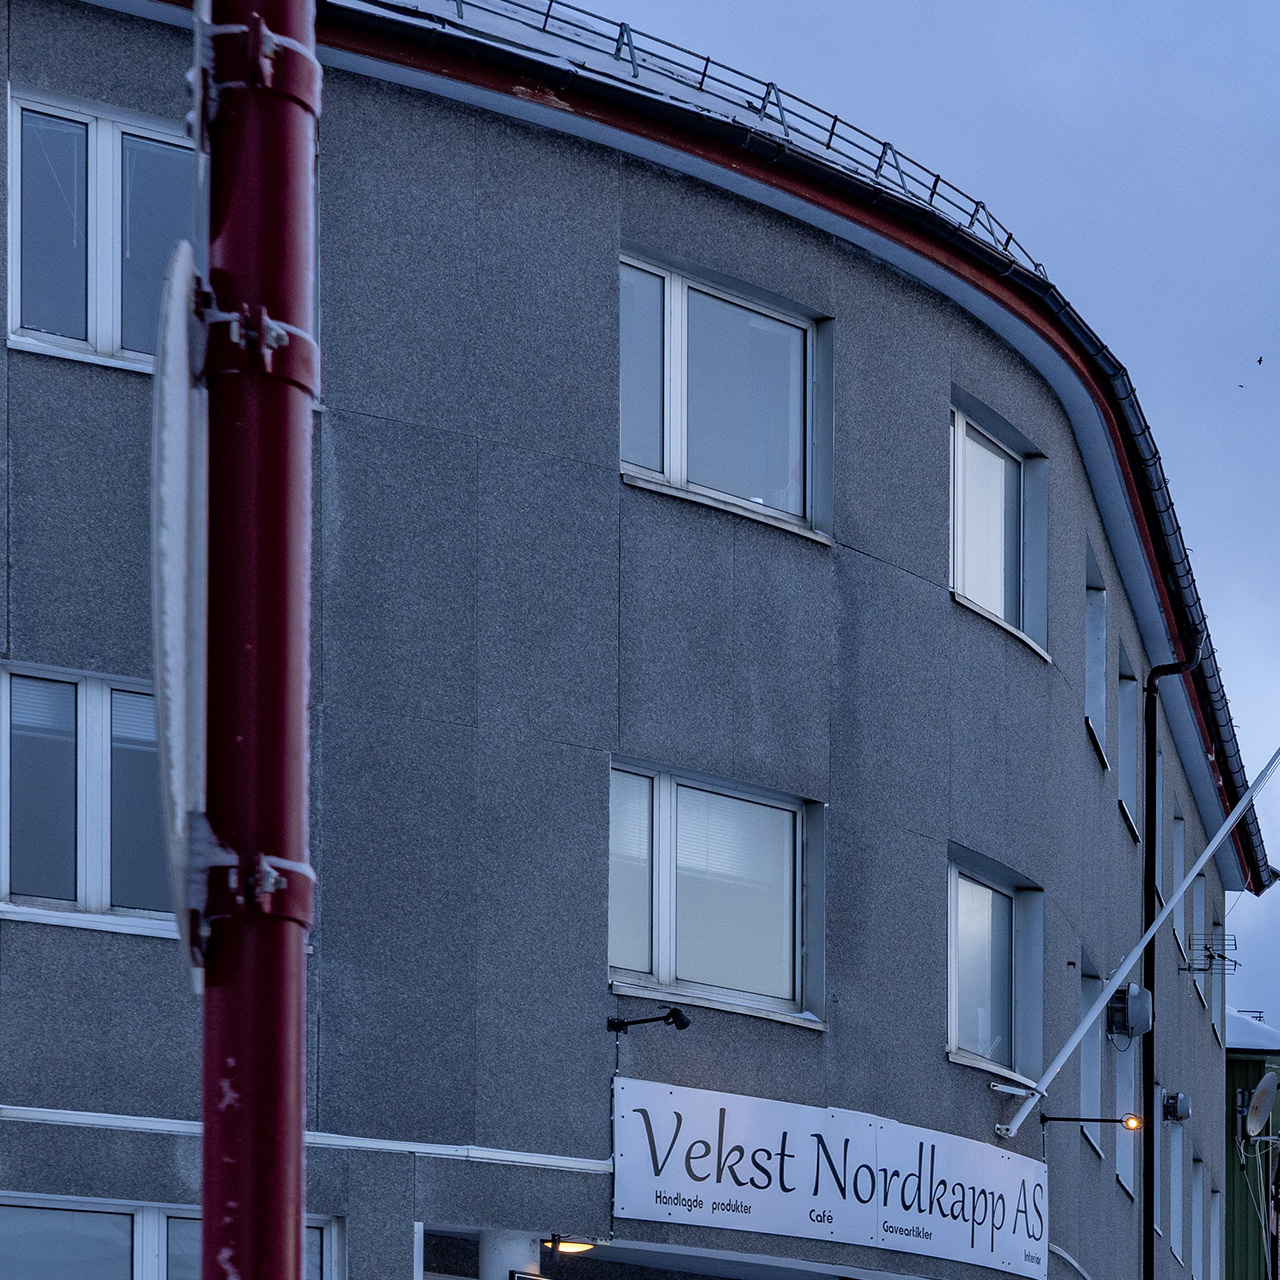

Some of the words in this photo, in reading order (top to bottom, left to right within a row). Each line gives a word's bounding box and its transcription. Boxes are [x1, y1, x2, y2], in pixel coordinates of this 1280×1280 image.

[632, 1107, 796, 1194] Vekst
[810, 1133, 1006, 1253] Nordkapp
[1012, 1179, 1044, 1242] AS
[655, 1189, 703, 1213] Håndlagde
[712, 1199, 752, 1215] produkter
[808, 1208, 834, 1224] Café
[882, 1220, 933, 1241] Gaveartikler
